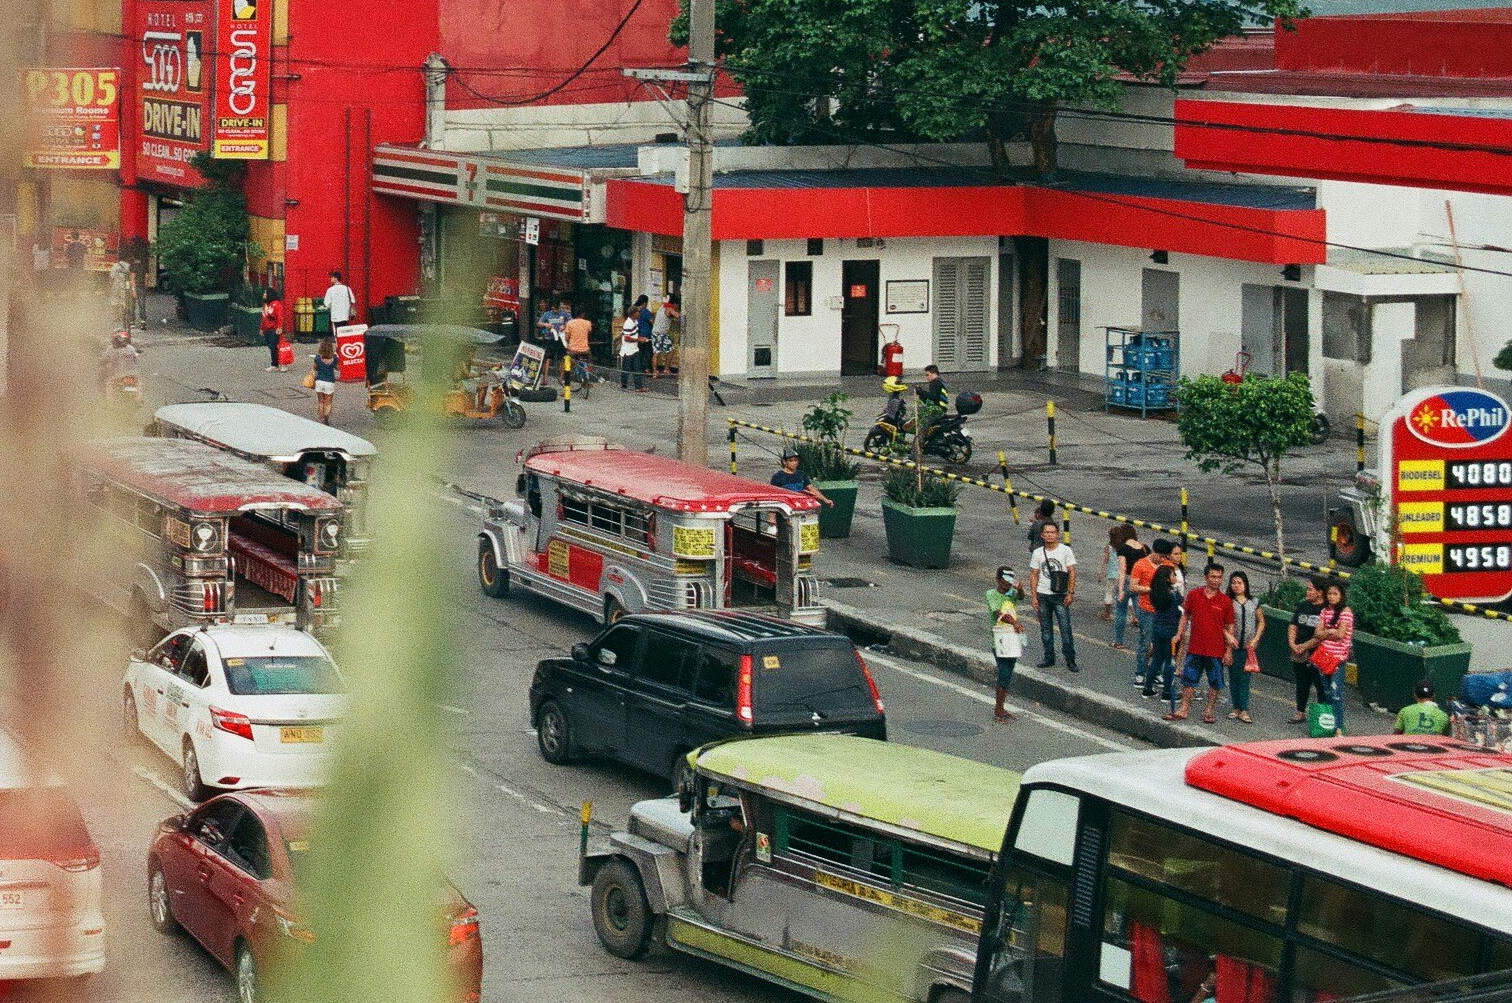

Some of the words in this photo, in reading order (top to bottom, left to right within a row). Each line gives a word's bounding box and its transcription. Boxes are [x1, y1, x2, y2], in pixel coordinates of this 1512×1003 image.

[148, 13, 176, 28] HOTEL
[229, 29, 258, 115] SOGO
[144, 101, 201, 139] DRIVE-IN
[221, 119, 263, 127] DRIVE-IN
[38, 156, 101, 165] ENTRANCE
[1440, 407, 1503, 428] RePhil
[1400, 471, 1442, 480] BIODIESEL
[1400, 512, 1441, 523] UNLEADED
[1400, 554, 1441, 566] PREMIUM
